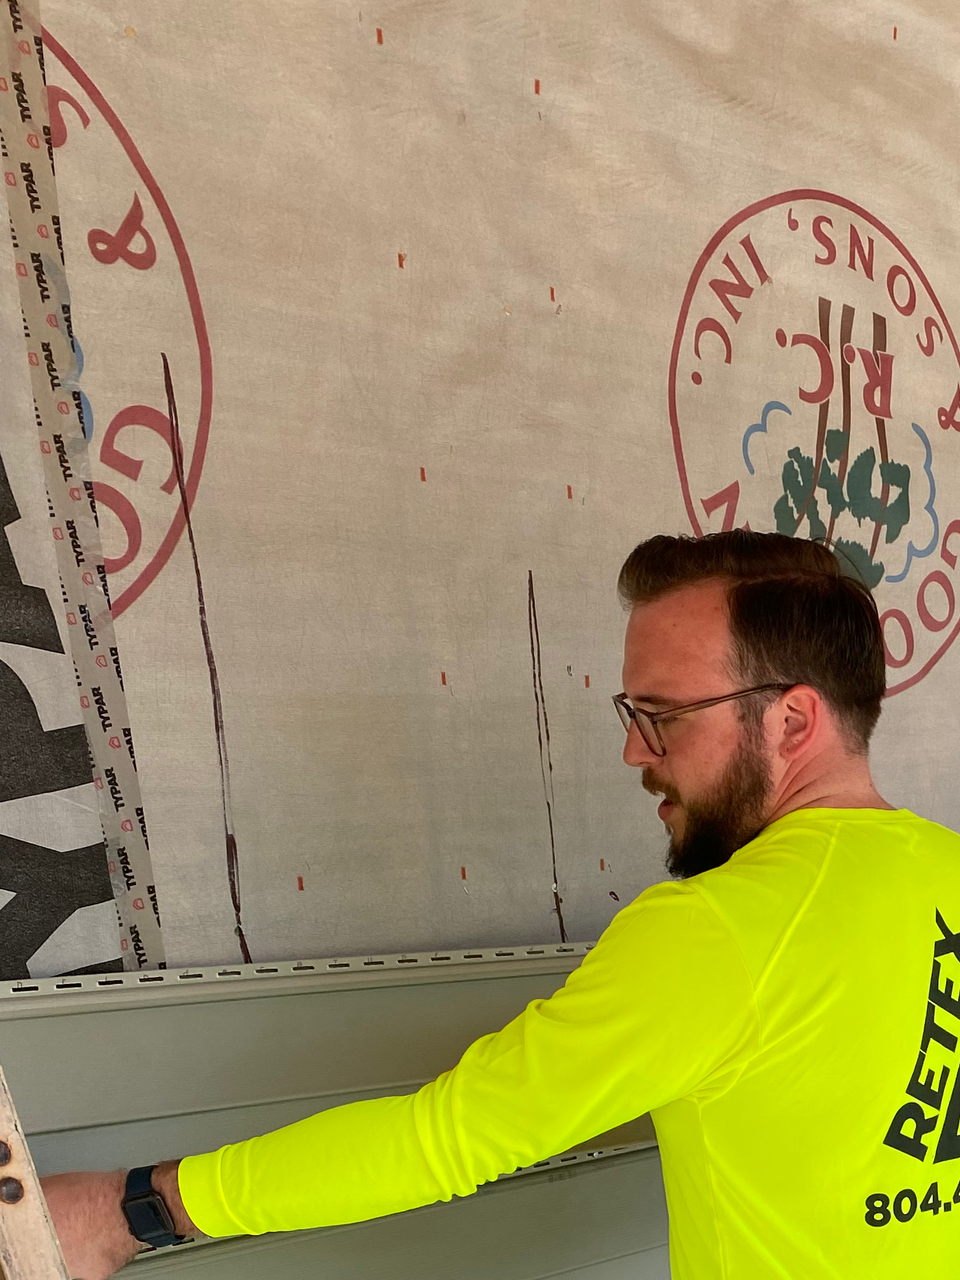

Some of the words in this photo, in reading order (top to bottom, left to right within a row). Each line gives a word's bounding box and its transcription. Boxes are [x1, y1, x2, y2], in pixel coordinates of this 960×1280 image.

[11, 71, 32, 124] TYPAR
[20, 162, 42, 214] TYPAR
[87, 191, 158, 271] &
[30, 252, 51, 303] TYPAR
[690, 233, 771, 387] INC.
[41, 341, 62, 392] TYPAR
[774, 327, 895, 420] R.C.
[52, 433, 74, 482] TYPAR
[65, 519, 86, 568] TYPAR
[79, 604, 100, 651] TYPAR
[91, 685, 113, 733] TYPAR
[104, 766, 126, 813] TYPAR
[116, 846, 138, 892] TYPAR
[128, 924, 149, 969] TYPAR
